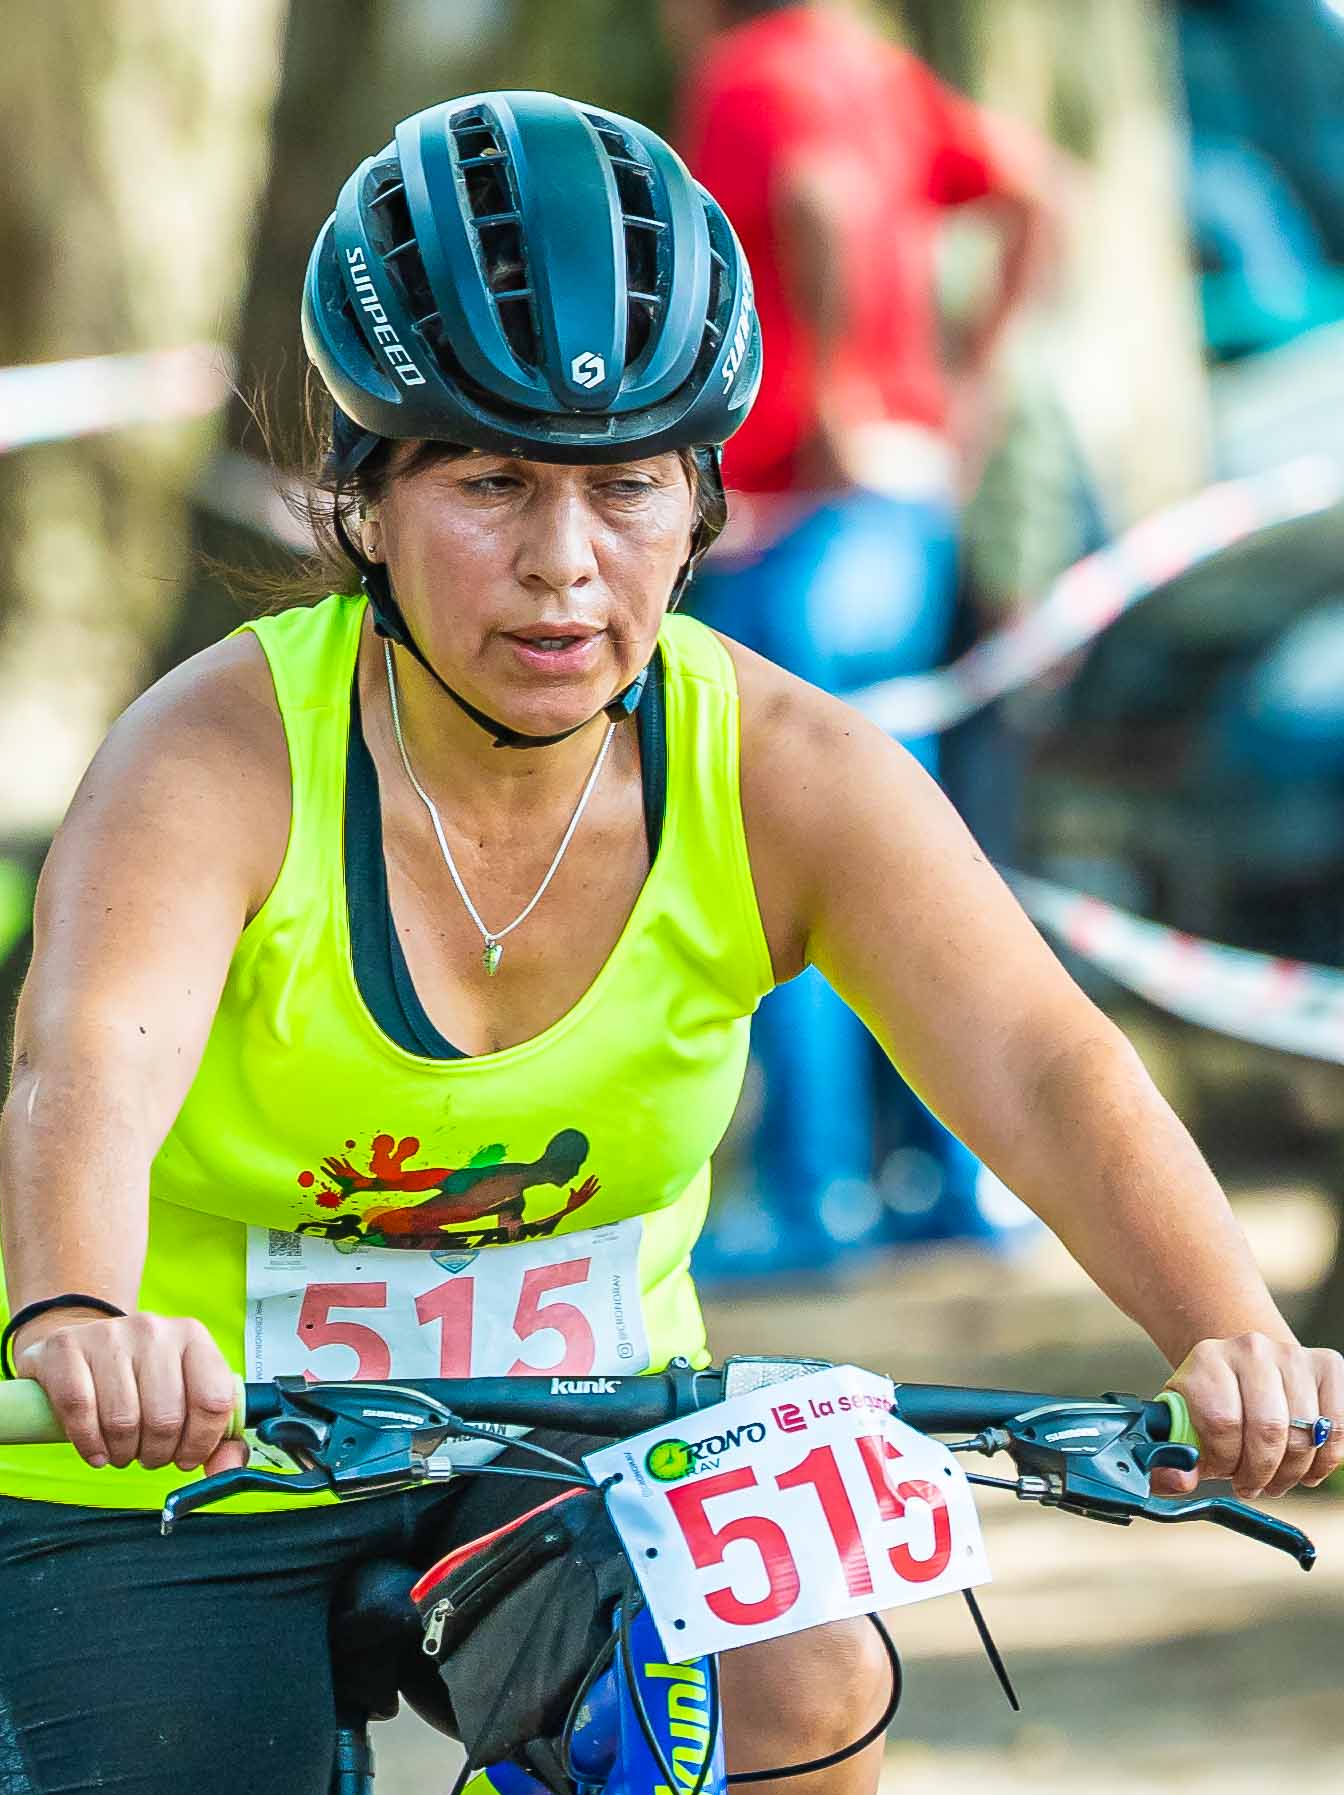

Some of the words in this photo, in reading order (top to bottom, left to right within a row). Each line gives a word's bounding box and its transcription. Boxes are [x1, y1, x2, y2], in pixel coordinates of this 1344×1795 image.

[345, 247, 427, 386] SUNPEED
[296, 1256, 595, 1382] 515
[550, 1377, 622, 1395] kunk
[808, 1399, 835, 1419] la
[664, 1434, 952, 1626] 515
